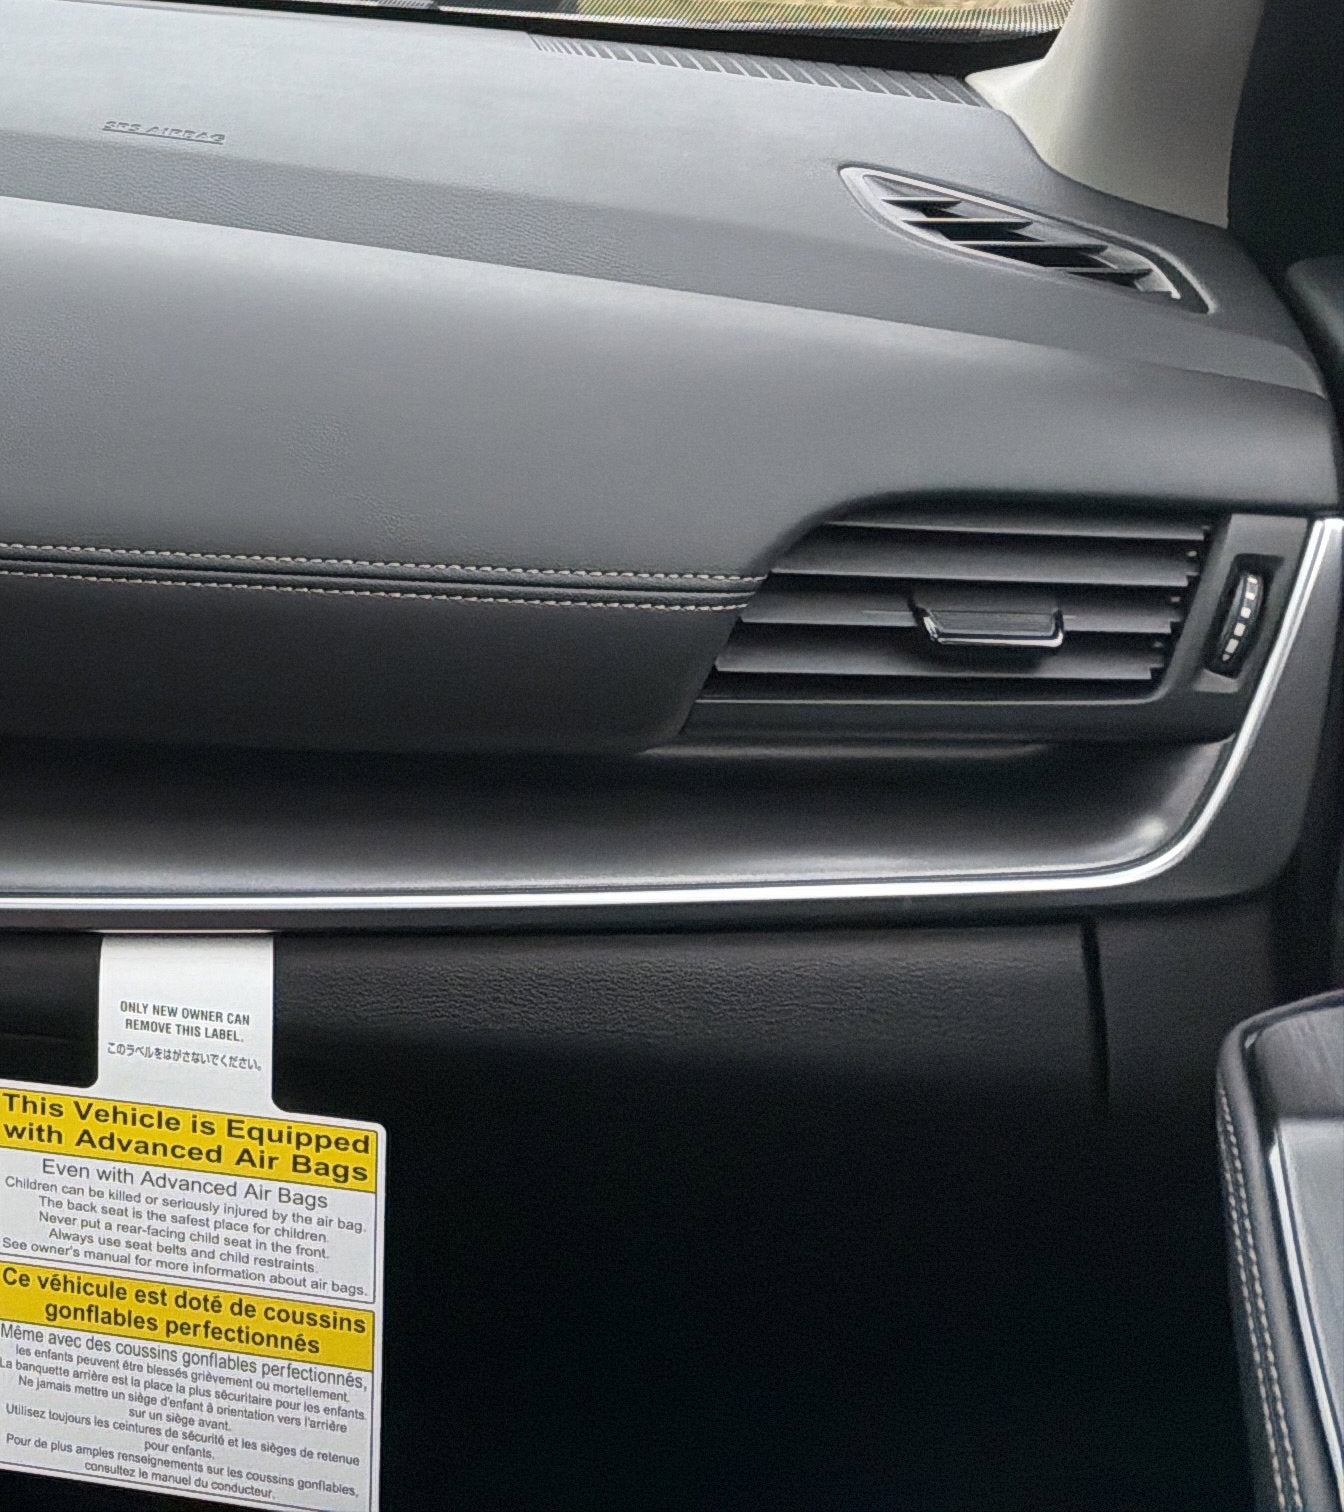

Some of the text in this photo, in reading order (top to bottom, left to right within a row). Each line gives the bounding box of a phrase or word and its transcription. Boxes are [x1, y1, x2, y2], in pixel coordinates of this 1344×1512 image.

[120, 1000, 249, 1025] ONLY NEW OWNER CAN
[125, 1018, 171, 1034] REMOVE
[174, 1023, 200, 1037] THIS
[2, 1092, 369, 1153] This Vehicle is Equipped
[2, 1122, 367, 1183] with Advanced Air Bags
[4, 1175, 57, 1192] Children
[61, 1185, 84, 1196] can
[88, 1185, 104, 1198] be
[108, 1189, 141, 1203] killed
[144, 1195, 158, 1205] or
[161, 1197, 220, 1215] seriously
[223, 1202, 268, 1219] injured
[271, 1208, 288, 1224] by
[291, 1212, 312, 1224] the
[316, 1215, 334, 1227] air
[42, 1158, 327, 1210] Even with Advanced Air Bags
[38, 1211, 78, 1225] Never
[80, 1218, 100, 1229] put
[104, 1221, 112, 1231] a
[116, 1223, 185, 1242] rear-facing
[188, 1231, 219, 1244] child
[223, 1236, 252, 1249] seat
[255, 1238, 267, 1250] in
[270, 1240, 292, 1254] the
[2, 1236, 27, 1250] See
[30, 1243, 80, 1257] owner's
[83, 1250, 130, 1263] manual
[134, 1254, 152, 1266] for
[155, 1259, 188, 1271] more
[192, 1262, 265, 1281] information
[268, 1273, 306, 1287] about
[310, 1278, 328, 1290] air
[2, 1266, 365, 1333] Ce véhicule est doté de coussins
[44, 1303, 319, 1353] gonflables perfectionnés
[0, 1323, 366, 1391] Même avec des coussins gonflables perfectionnés,
